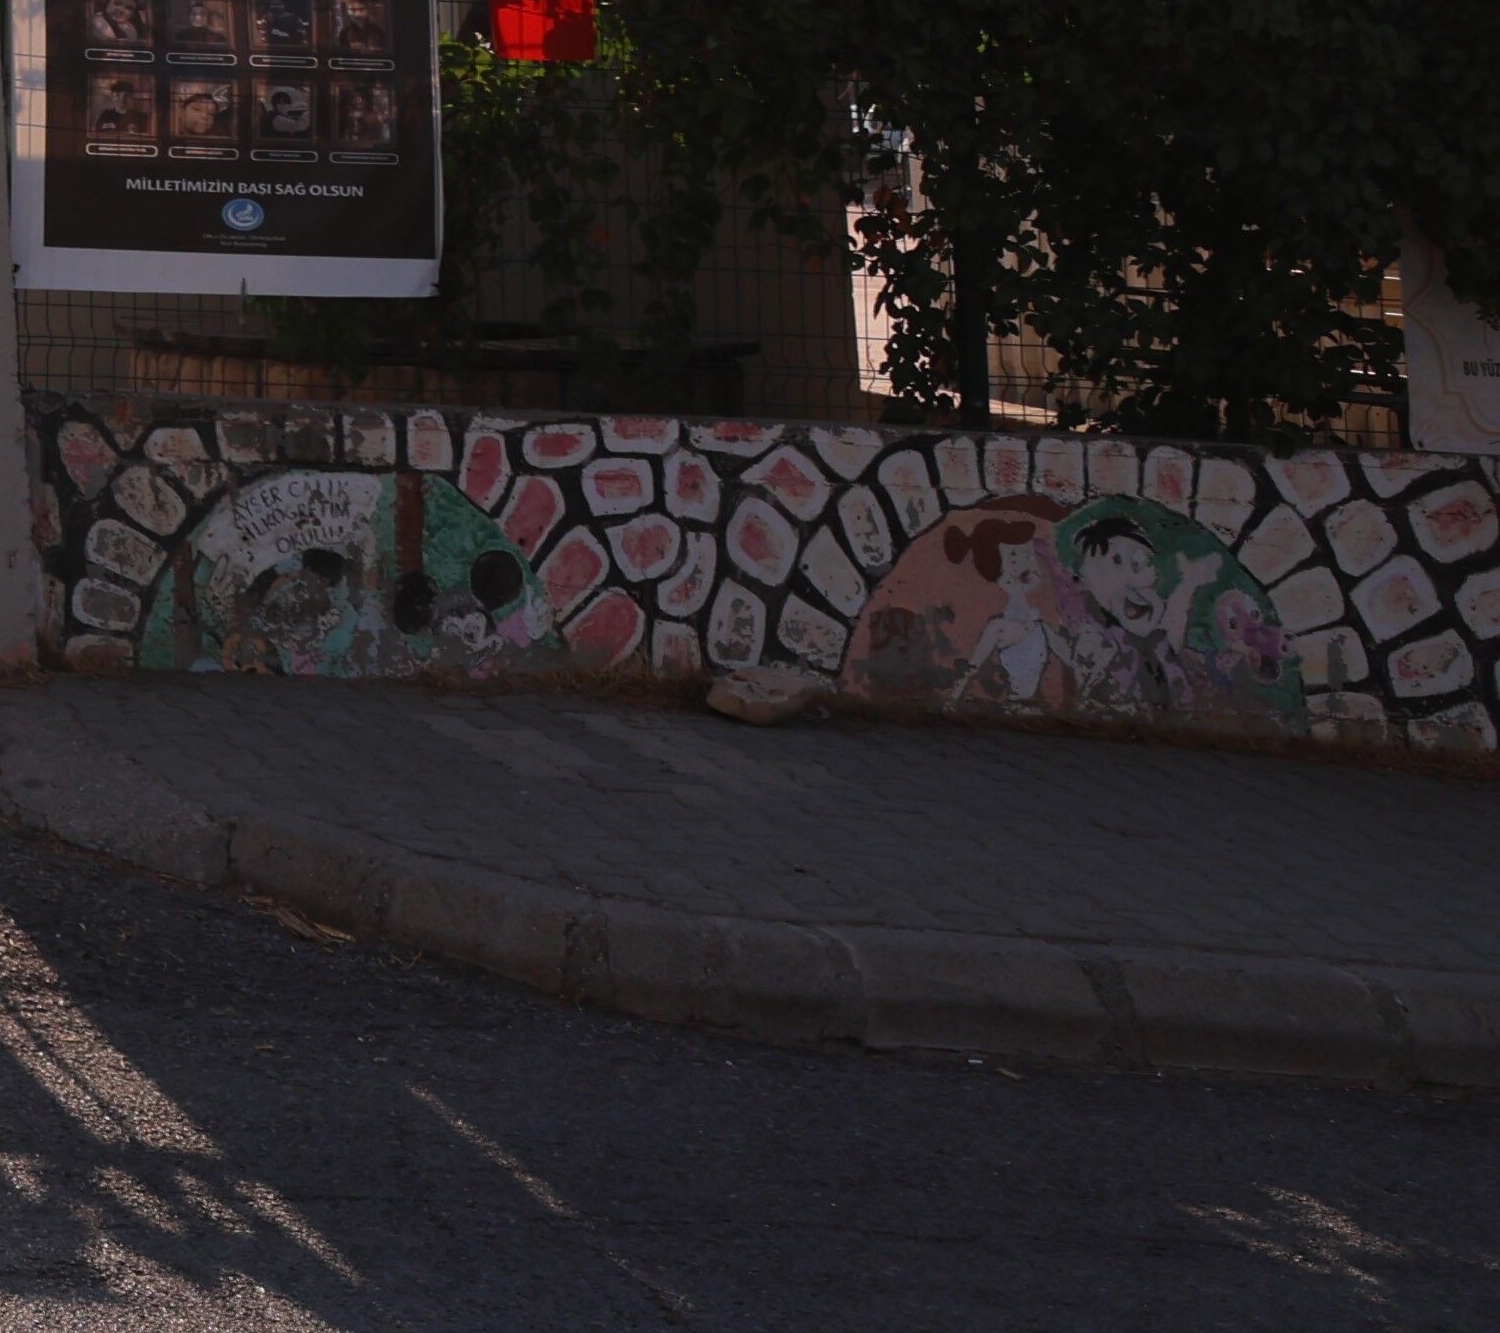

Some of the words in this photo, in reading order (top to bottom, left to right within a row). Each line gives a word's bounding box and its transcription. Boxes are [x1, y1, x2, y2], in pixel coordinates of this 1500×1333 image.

[125, 176, 234, 194] MİLLETİMİZİN
[238, 181, 272, 197] BAŞI
[275, 179, 307, 196] SAĞ
[309, 183, 365, 198] OLSUN
